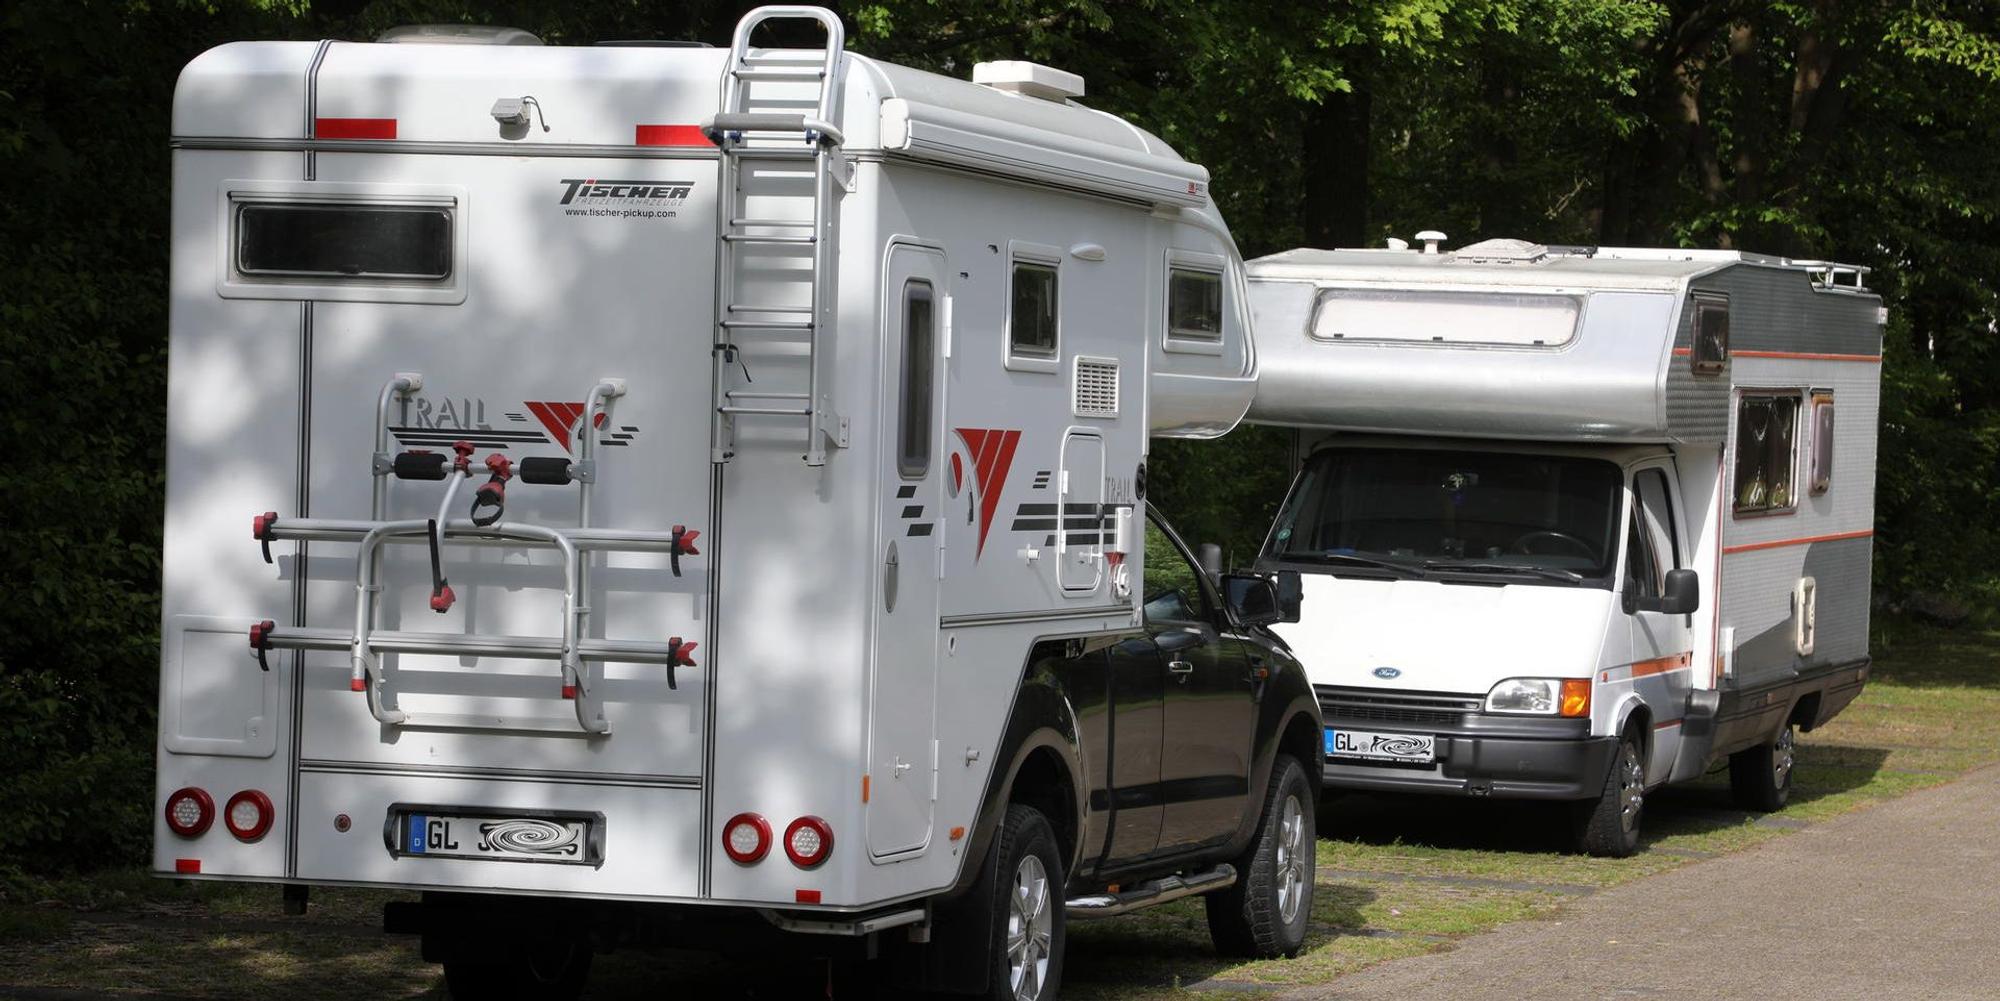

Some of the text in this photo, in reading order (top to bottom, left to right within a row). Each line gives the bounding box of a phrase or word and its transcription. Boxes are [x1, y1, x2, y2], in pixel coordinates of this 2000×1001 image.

[565, 208, 677, 218] www.tischer-pickup.com
[394, 397, 493, 431] TRAIL
[1377, 668, 1398, 678] Ford
[1335, 733, 1358, 752] GL
[414, 837, 421, 847] D
[428, 820, 459, 850] GL
